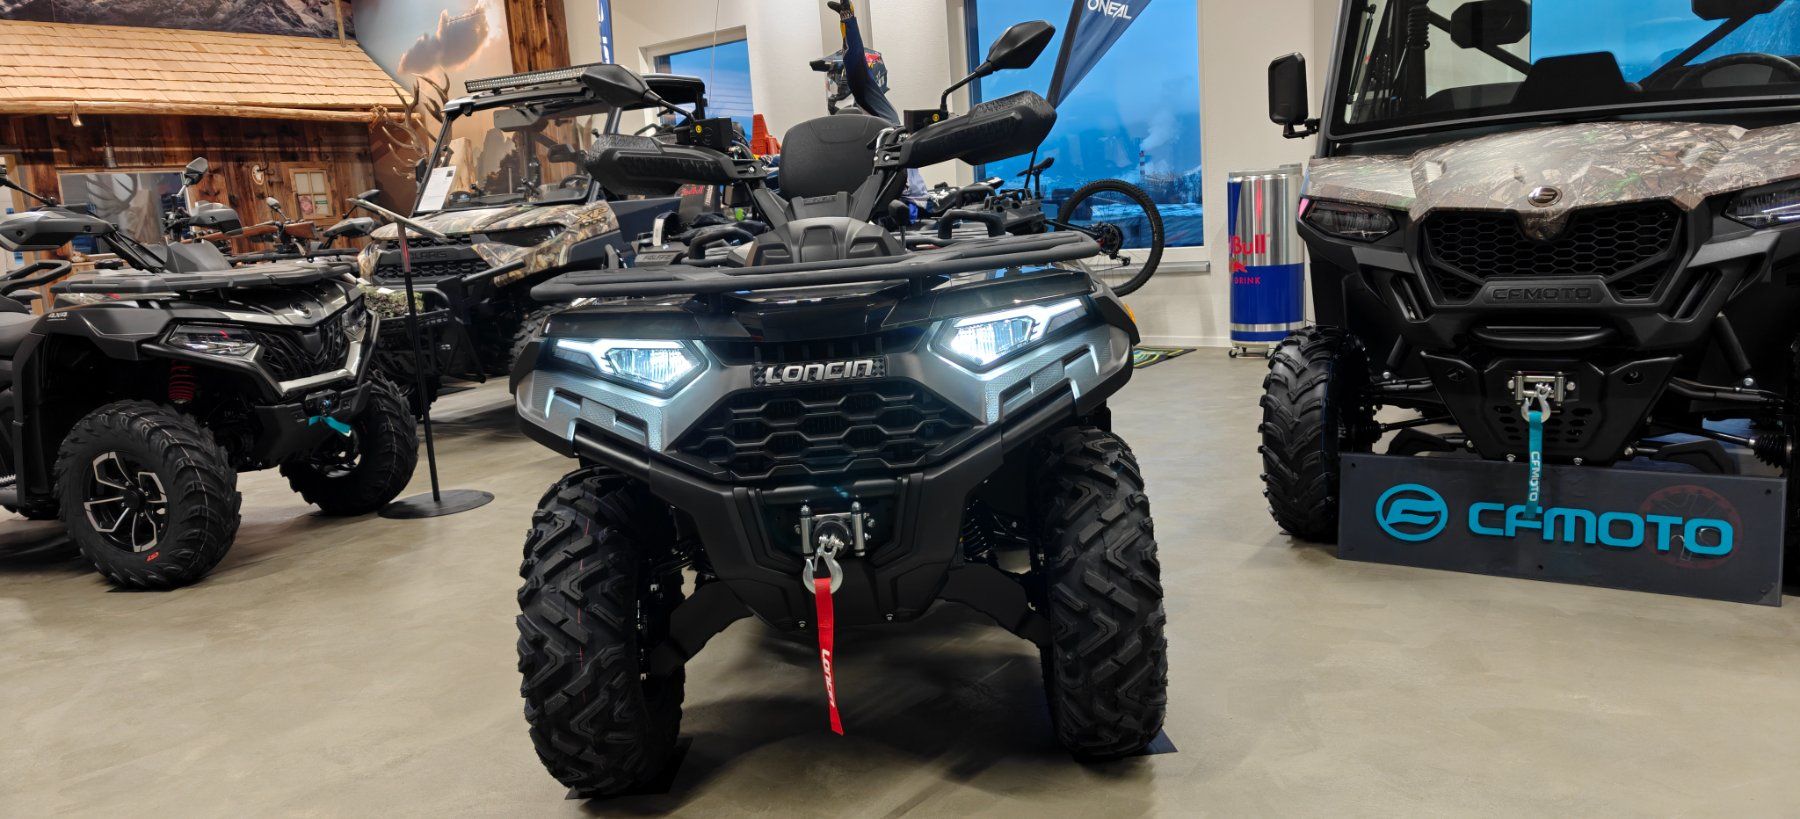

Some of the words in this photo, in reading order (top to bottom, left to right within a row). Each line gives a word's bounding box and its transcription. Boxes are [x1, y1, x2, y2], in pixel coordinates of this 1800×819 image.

[1492, 287, 1592, 300] CFMOTO
[765, 360, 874, 385] LONCIN
[1529, 451, 1541, 502] CFMOTO
[1468, 501, 1734, 556] CFMOTO
